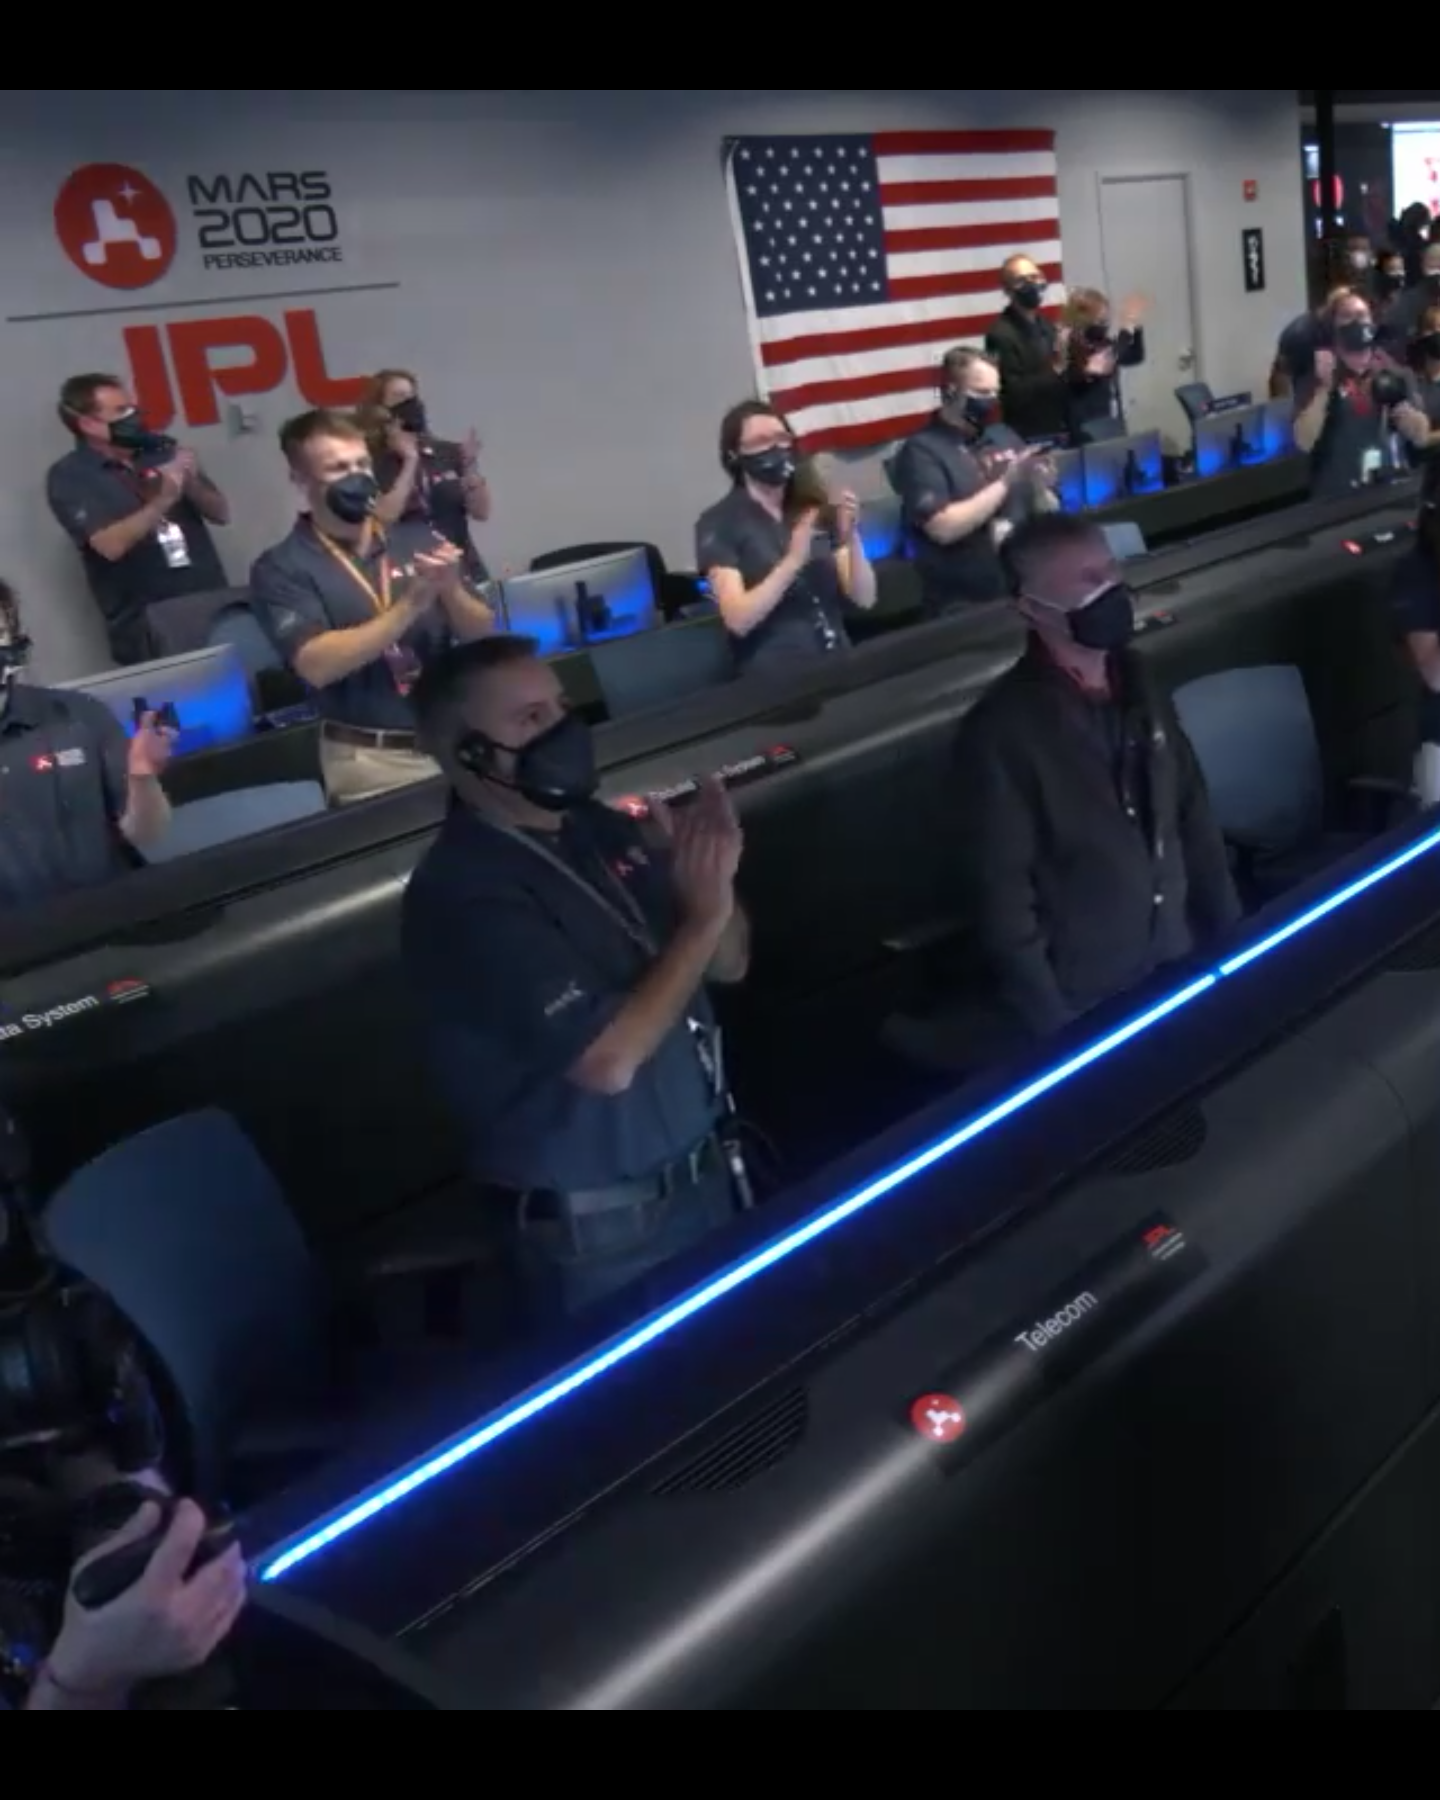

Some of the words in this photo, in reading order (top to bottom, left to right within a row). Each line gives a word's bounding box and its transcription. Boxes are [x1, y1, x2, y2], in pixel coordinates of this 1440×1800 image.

[187, 170, 331, 205] MARS
[193, 204, 338, 248] 2020
[203, 247, 343, 270] PERSEVERANCE
[121, 307, 377, 432] JPL
[22, 995, 99, 1029] System
[1014, 1291, 1098, 1351] Telecom
